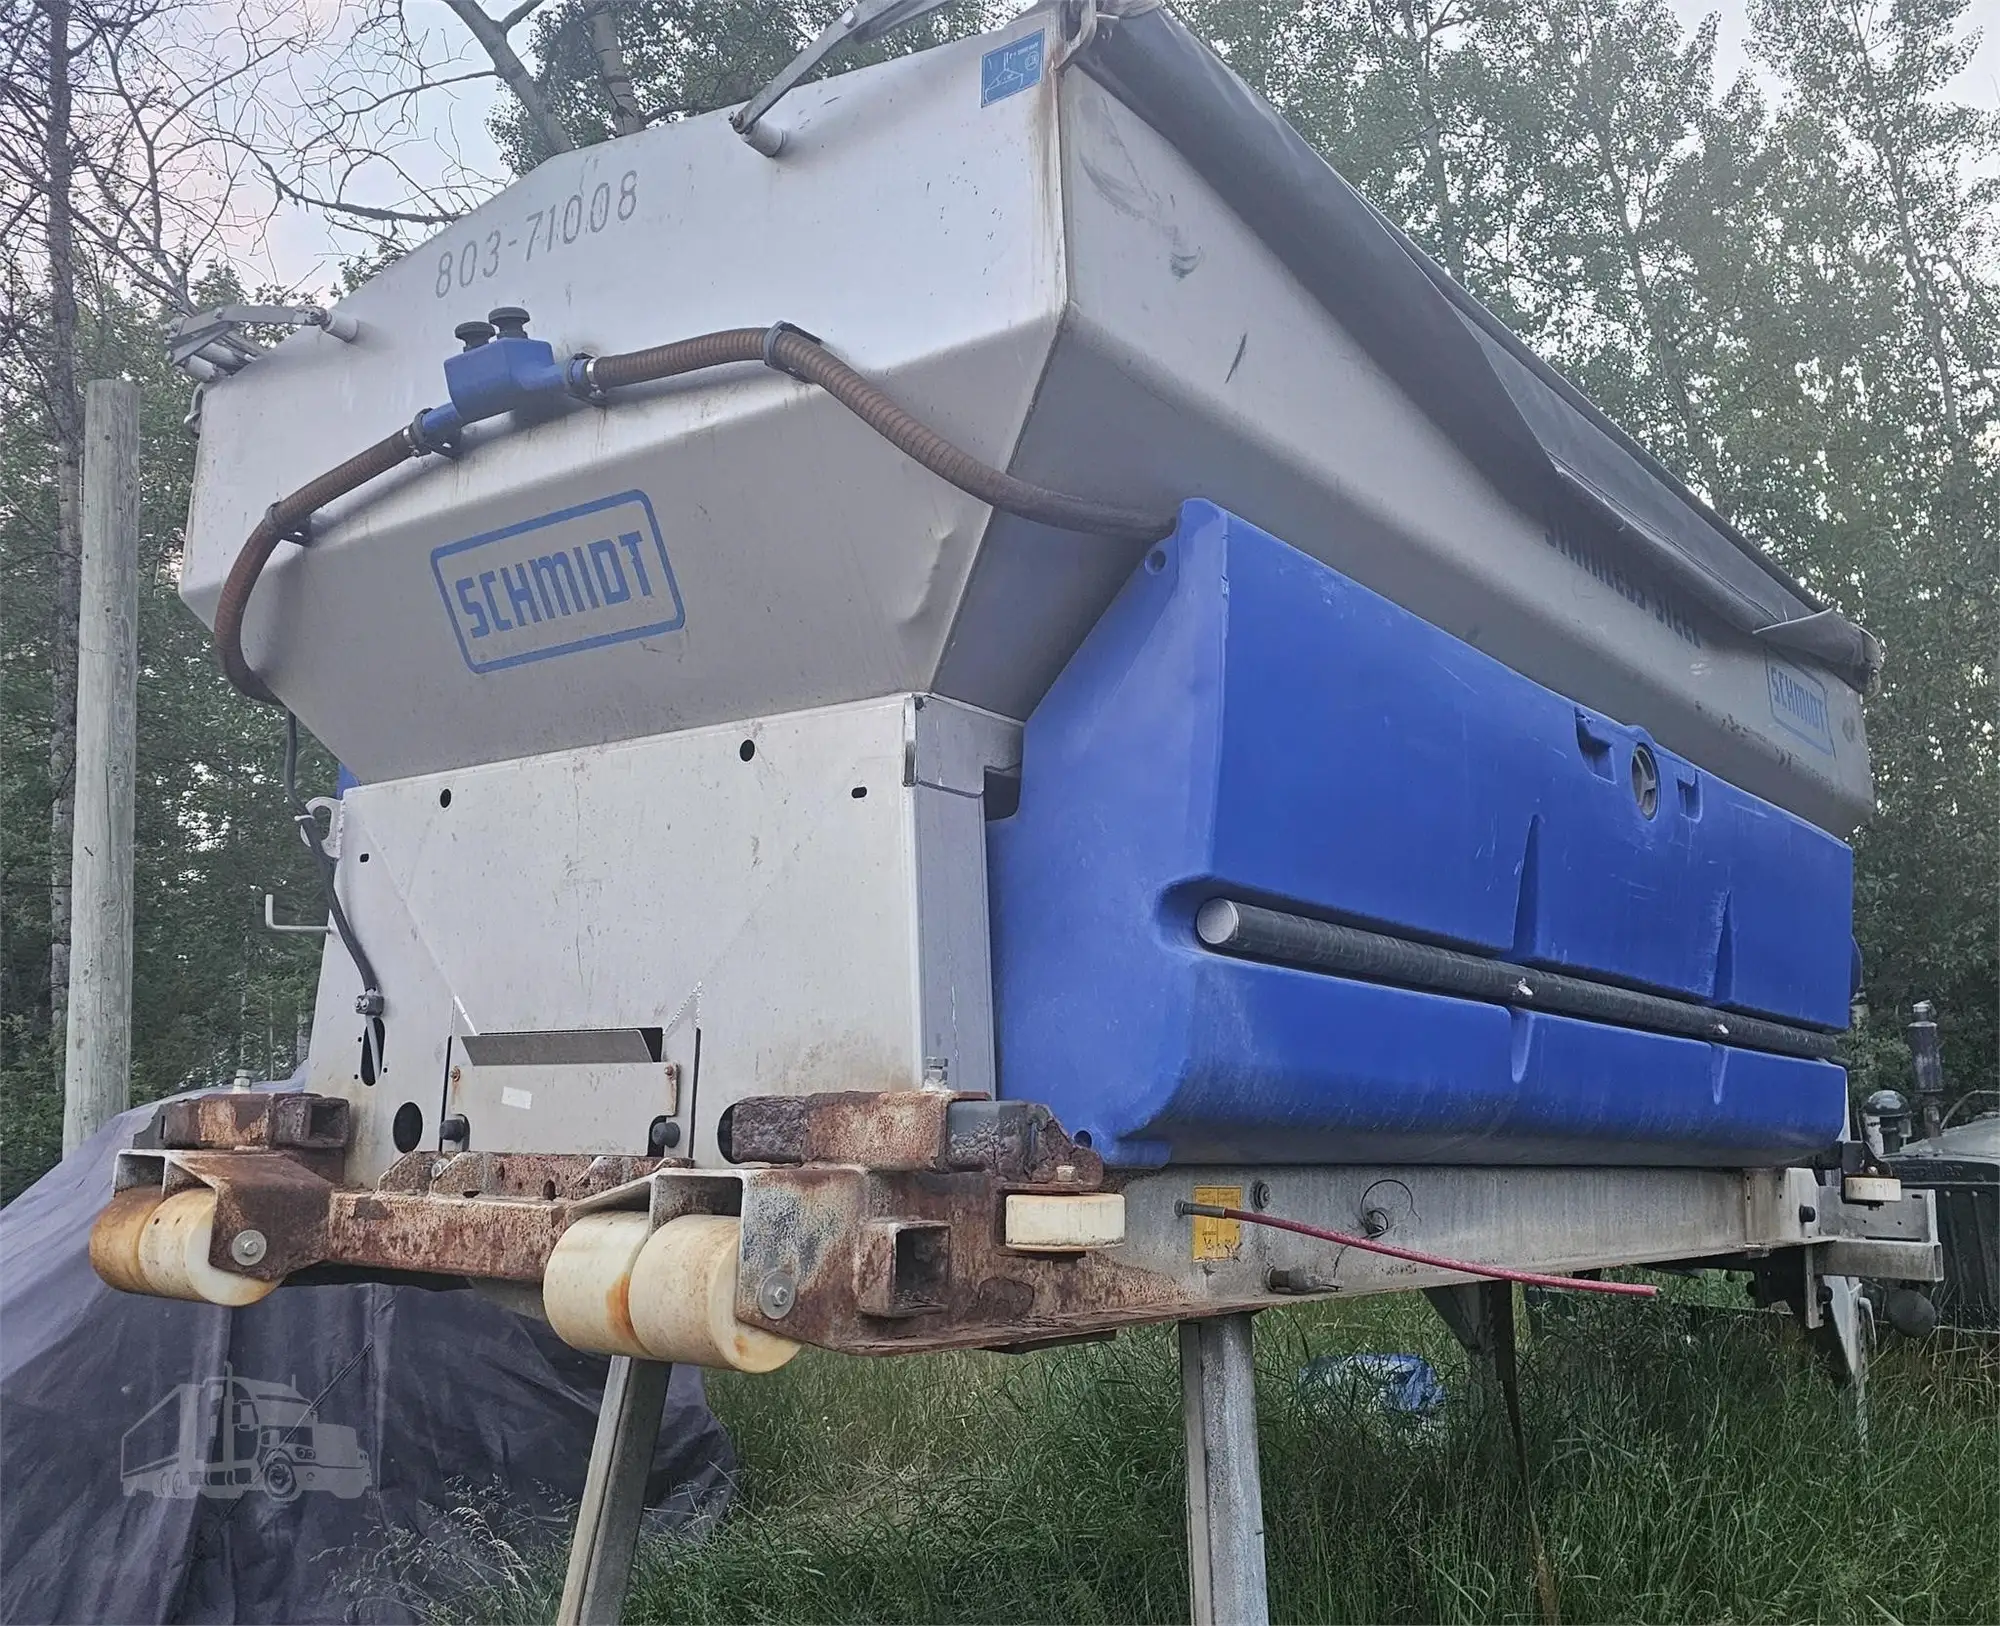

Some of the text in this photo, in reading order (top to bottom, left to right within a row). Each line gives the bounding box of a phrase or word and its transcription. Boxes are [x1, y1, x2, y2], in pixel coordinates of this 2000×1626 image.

[435, 169, 638, 298] 803-71008
[455, 530, 654, 639] SCHMIDT
[1770, 666, 1826, 733] SCHMIDT
